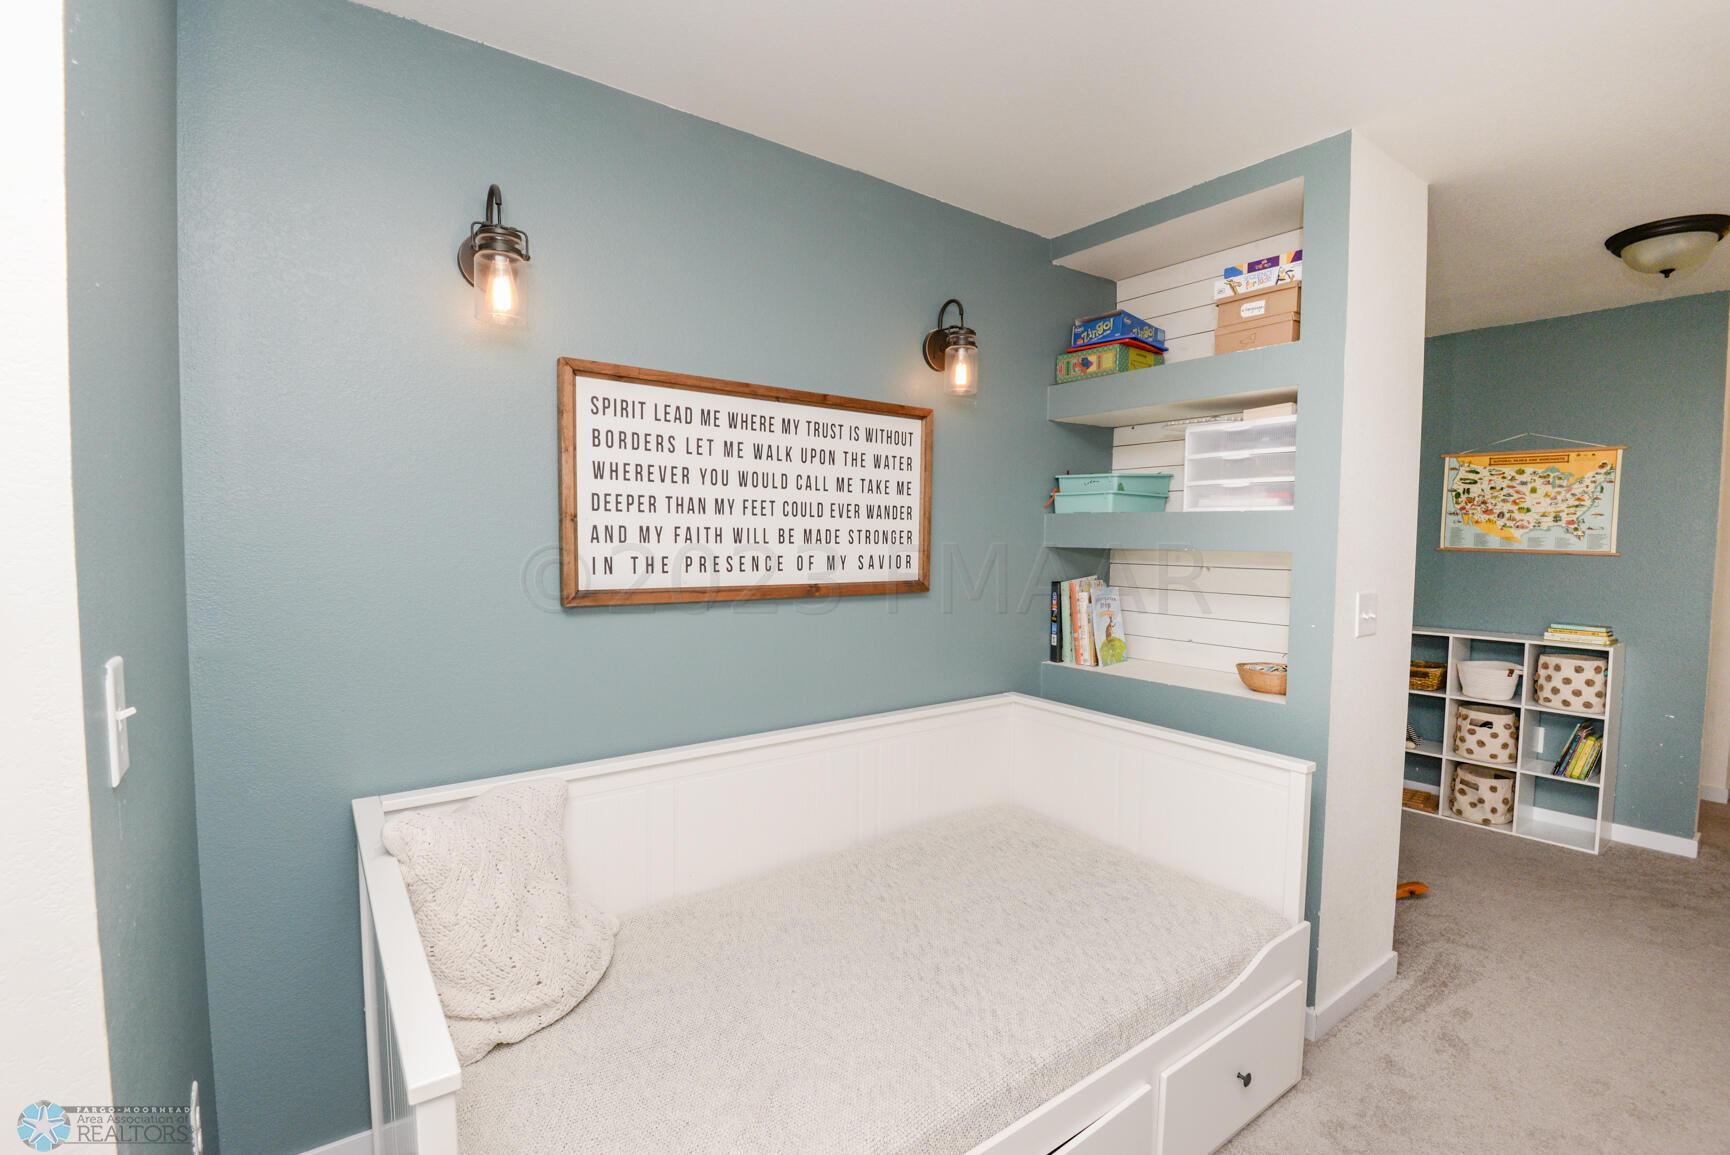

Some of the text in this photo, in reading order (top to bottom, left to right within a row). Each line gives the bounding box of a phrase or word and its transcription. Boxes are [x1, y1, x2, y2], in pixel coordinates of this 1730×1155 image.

[1081, 317, 1113, 342] Zingo!
[590, 395, 914, 447] SPIRIT LEAD ME WHERE MY TRUST IS WITHOUT
[591, 428, 913, 472] BORDERS LET ME WALK UPON THE WATER
[592, 460, 912, 497] WHEREVER YOU WOULD CALL ME TAKE ME
[591, 492, 913, 521] DEEPER THAN MY FEET COULD EVER WANDER
[590, 524, 913, 545] AND MY FAITH WILL BE MADE STRONGER
[592, 554, 912, 576] IN THE PRESENCE OF MY SAVIOR
